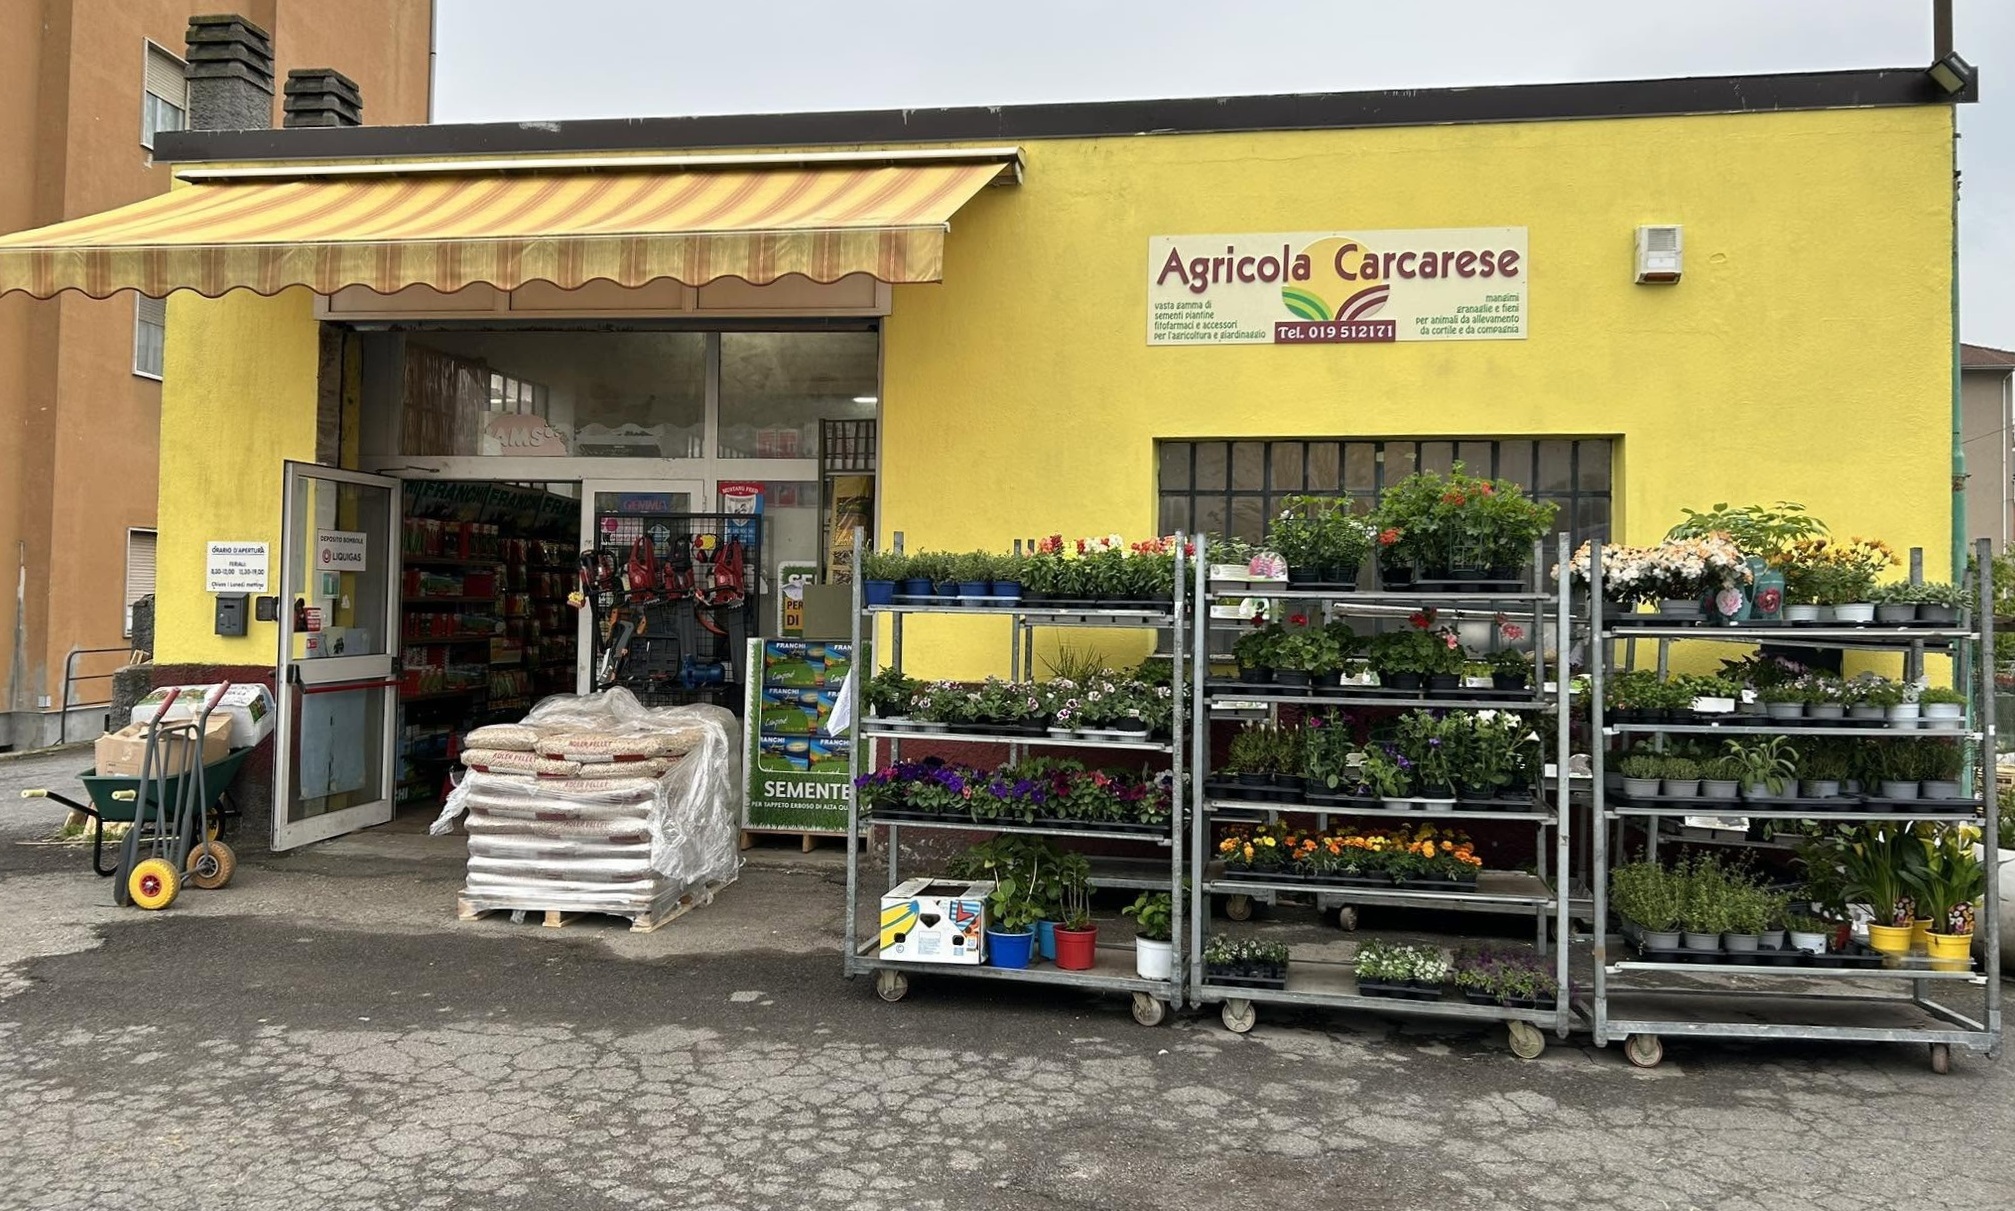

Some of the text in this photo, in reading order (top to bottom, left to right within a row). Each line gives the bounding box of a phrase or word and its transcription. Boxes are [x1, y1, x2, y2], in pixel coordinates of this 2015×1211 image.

[1156, 243, 1520, 294] Agricola Carcarese
[1485, 293, 1519, 303] mangimi
[1154, 300, 1212, 311] vasta gamma di
[1456, 305, 1493, 314] granaglie
[1501, 304, 1519, 313] fieni
[1154, 311, 1214, 320] sementi piantine
[1415, 314, 1519, 325] per animali da allevamento
[1154, 320, 1238, 330] fitofarmaci e accessori
[1419, 326, 1430, 335] da
[1431, 325, 1457, 335] cortile
[1465, 325, 1475, 335] da
[1476, 324, 1519, 335] compagnia
[1154, 332, 1166, 341] per
[1219, 330, 1266, 340] giardinaggio
[1277, 325, 1393, 339] Tel. 019 512171
[746, 486, 759, 494] FEED
[320, 535, 364, 545] DEPOSITO BOMBOLE
[233, 546, 265, 554] D'APERTURA
[332, 552, 362, 562] LIQUIGAS
[776, 642, 806, 650] FRANCHI
[820, 739, 850, 747] FRANCH
[764, 802, 789, 810] TAPPETO
[790, 802, 815, 810] ERBOSO
